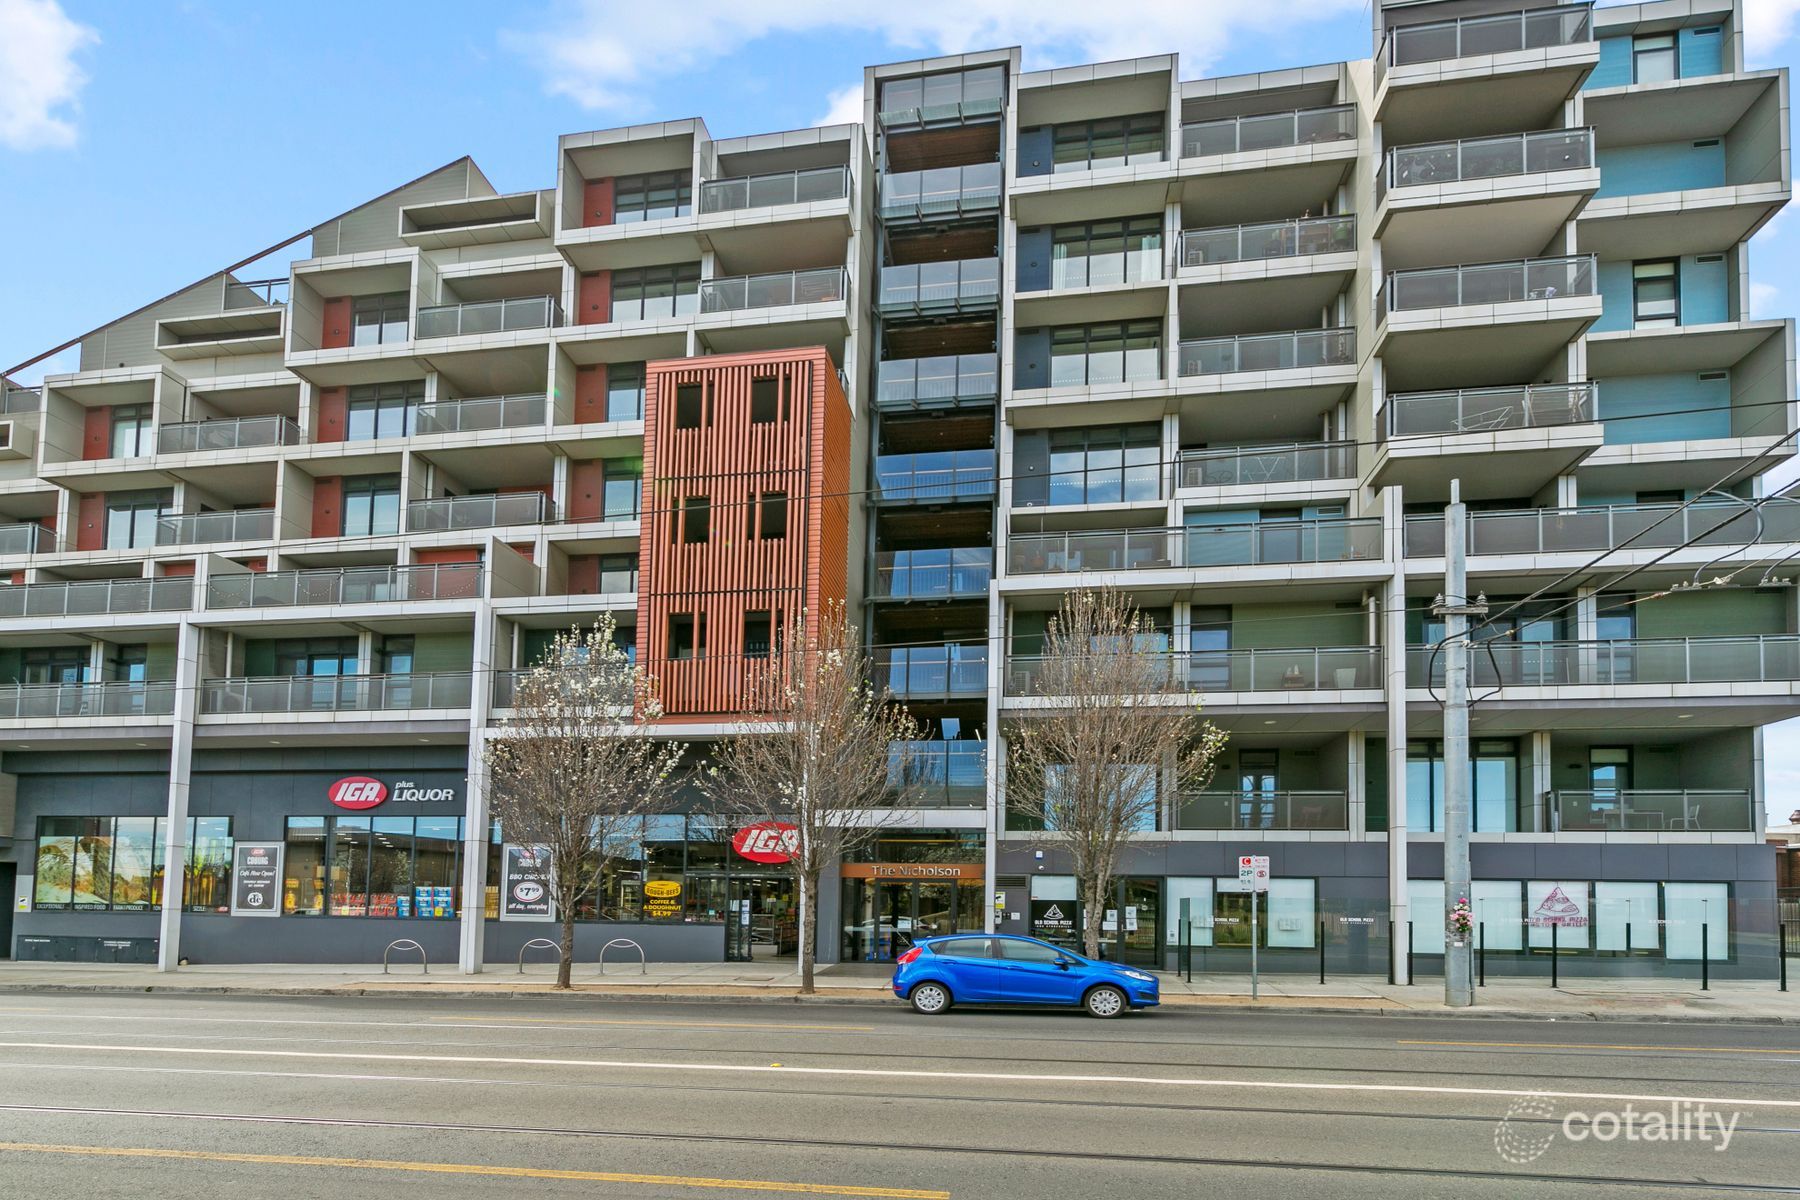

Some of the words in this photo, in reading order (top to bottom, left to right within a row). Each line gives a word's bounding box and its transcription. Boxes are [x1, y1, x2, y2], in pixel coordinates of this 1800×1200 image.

[395, 781, 414, 789] plus
[335, 782, 380, 802] IGA
[393, 789, 454, 801] LIQUOR
[740, 829, 799, 853] IGA
[872, 866, 896, 876] The
[899, 866, 961, 876] Nicholson
